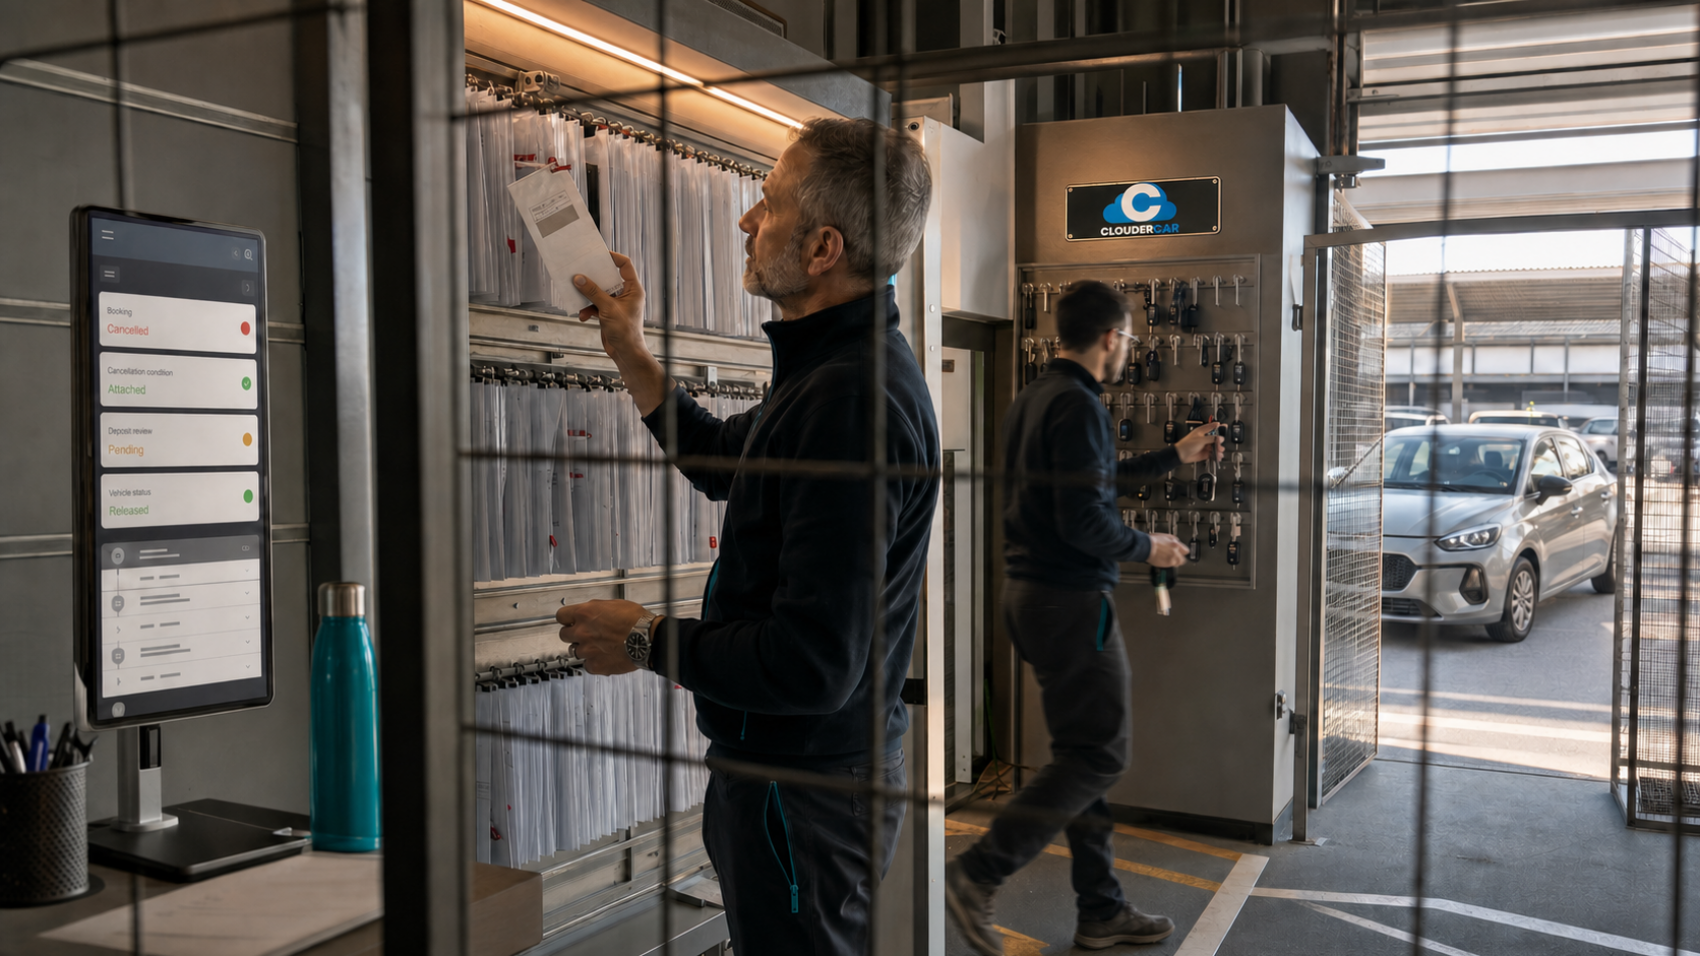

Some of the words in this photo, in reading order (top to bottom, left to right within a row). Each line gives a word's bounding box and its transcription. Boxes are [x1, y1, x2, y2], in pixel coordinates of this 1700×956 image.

[1121, 183, 1161, 222] C
[1101, 224, 1179, 236] CLOUDERCAR
[107, 306, 132, 317] Booking
[107, 323, 149, 336] Cancelled
[107, 366, 145, 376] Cancellation
[147, 368, 173, 377] condition
[108, 384, 146, 395] Attached
[108, 427, 132, 436] Deposit
[108, 444, 144, 457] Pending
[109, 489, 131, 497] Vehicle
[109, 505, 149, 516] Released
